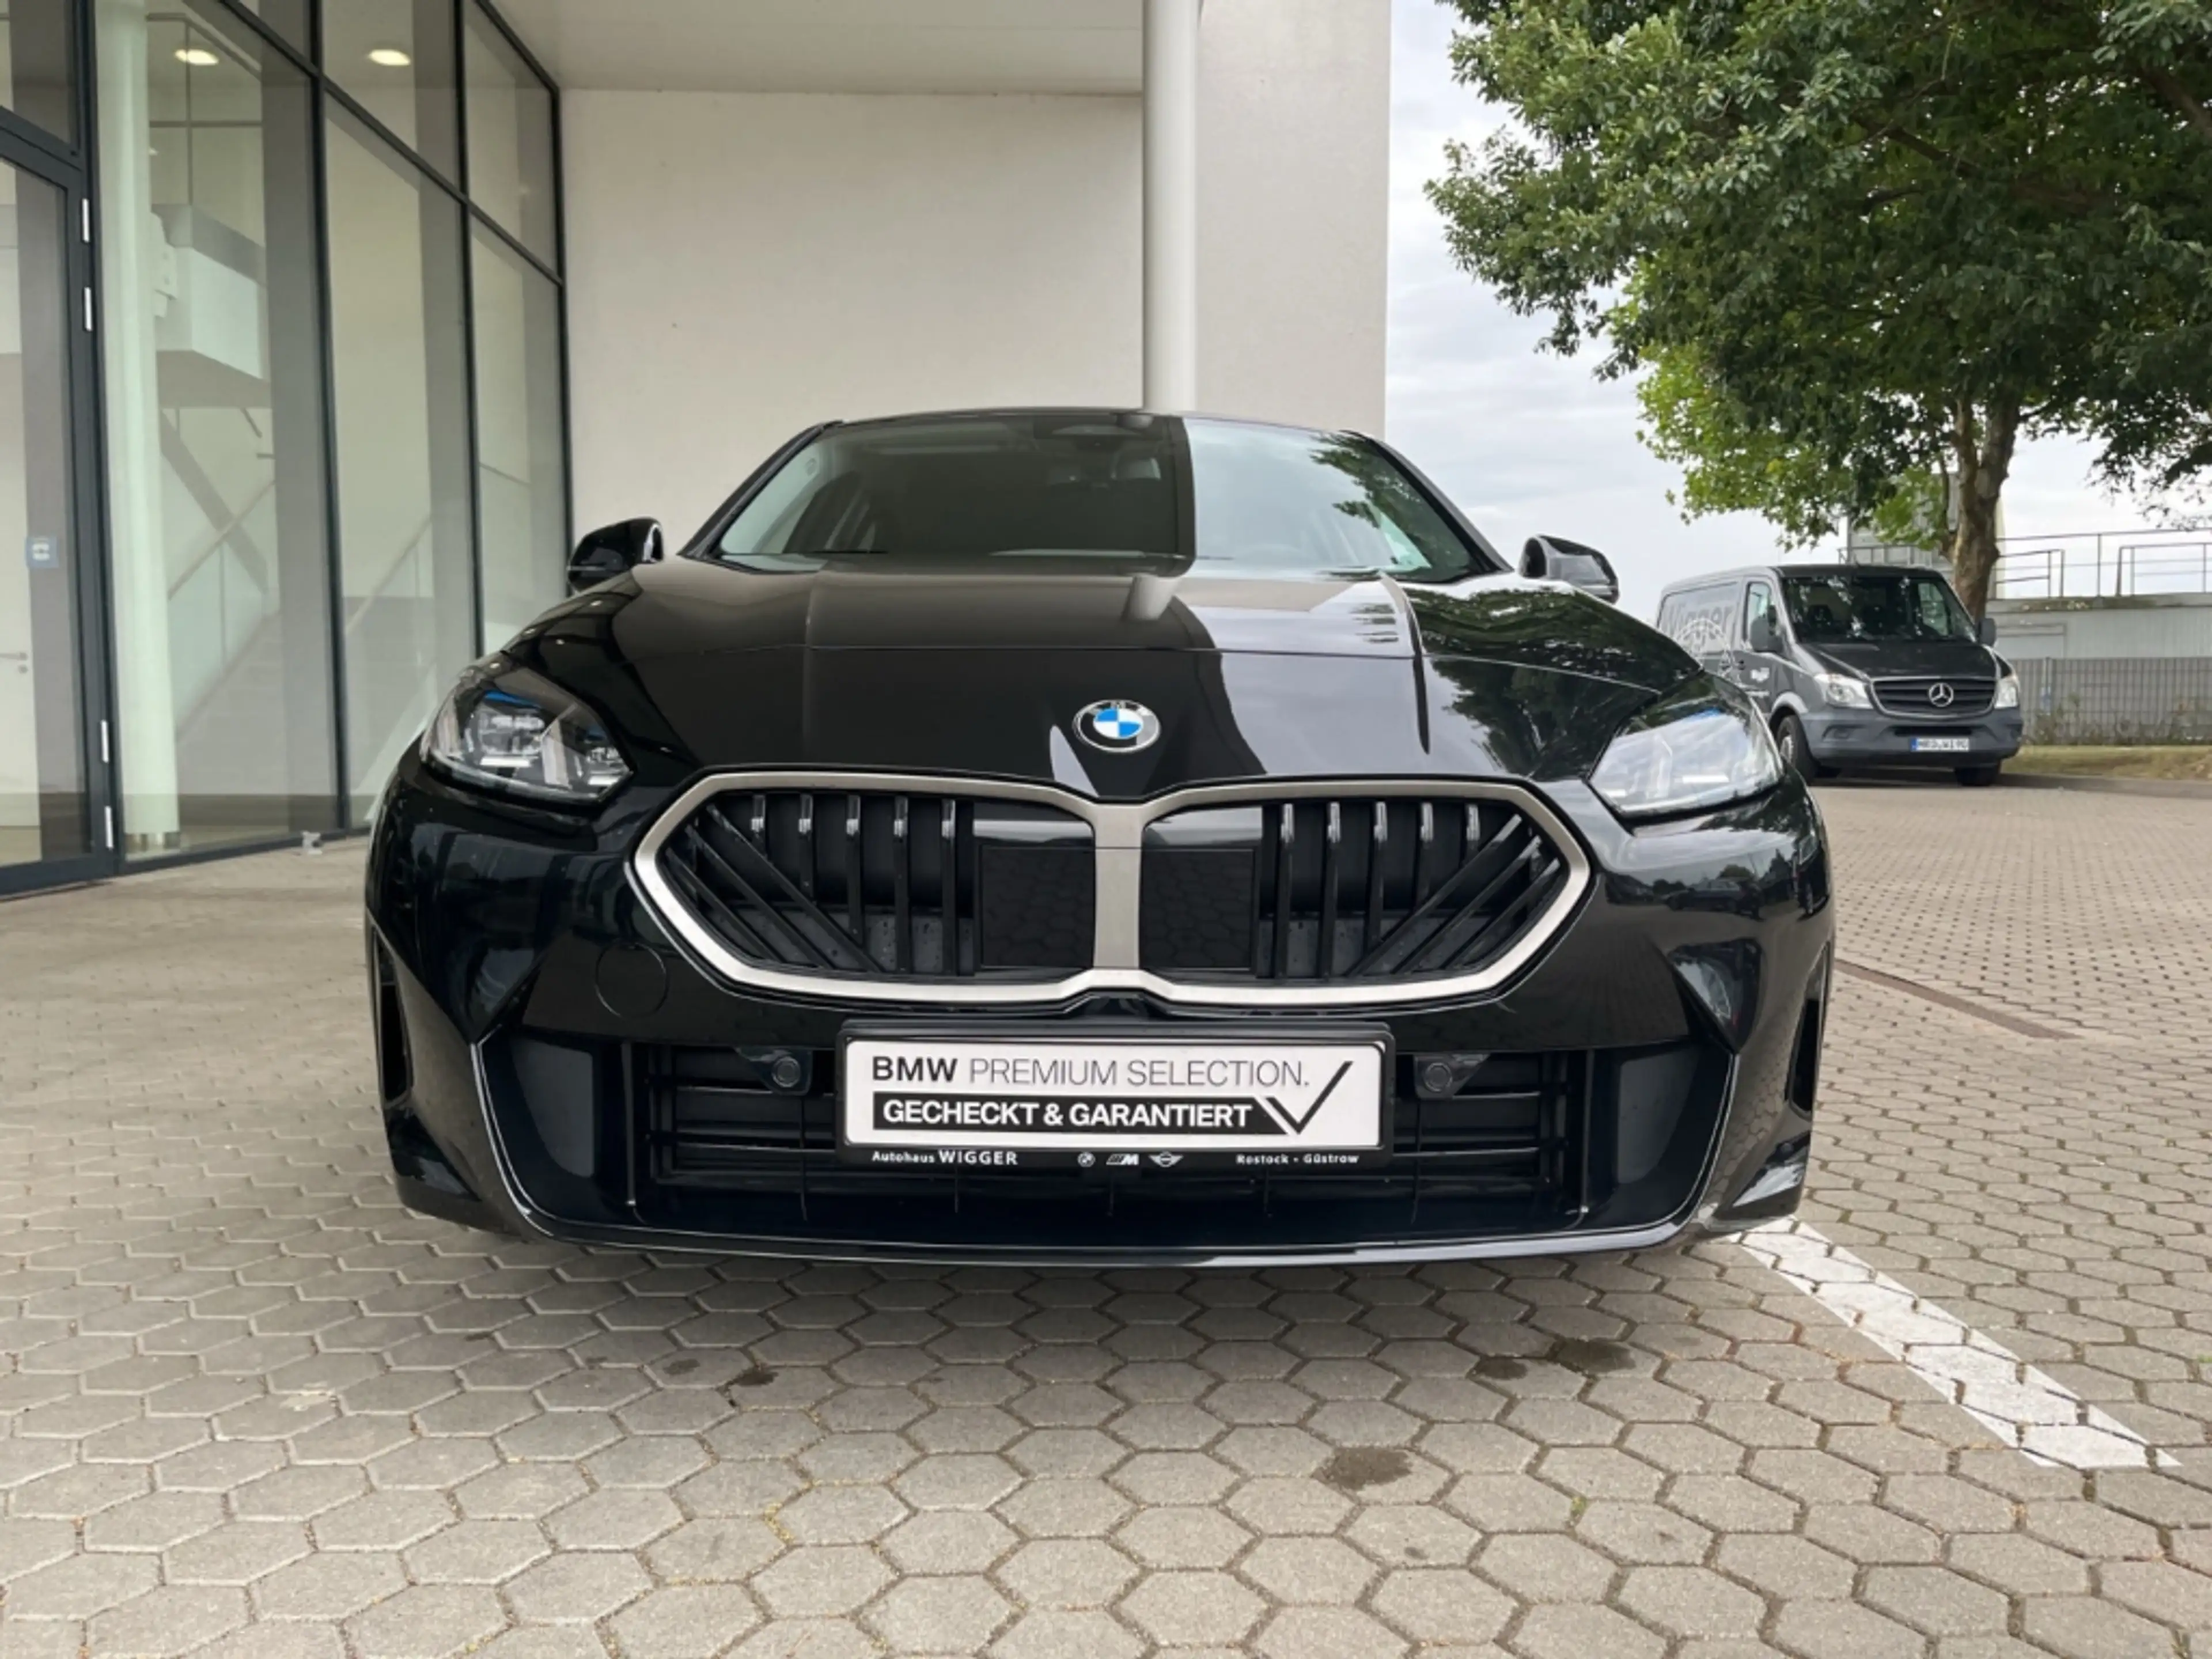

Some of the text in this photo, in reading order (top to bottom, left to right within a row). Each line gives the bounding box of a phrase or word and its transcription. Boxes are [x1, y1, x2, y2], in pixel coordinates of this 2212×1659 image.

[872, 1055, 1310, 1087] BMW PREMIUM SELECTION.
[882, 1099, 1253, 1128] GECHECKT & GARANTIERT
[871, 1149, 1018, 1165] Autohaus WIGGER
[1236, 1153, 1289, 1165] Rostock
[1302, 1153, 1360, 1165] Güstrow
